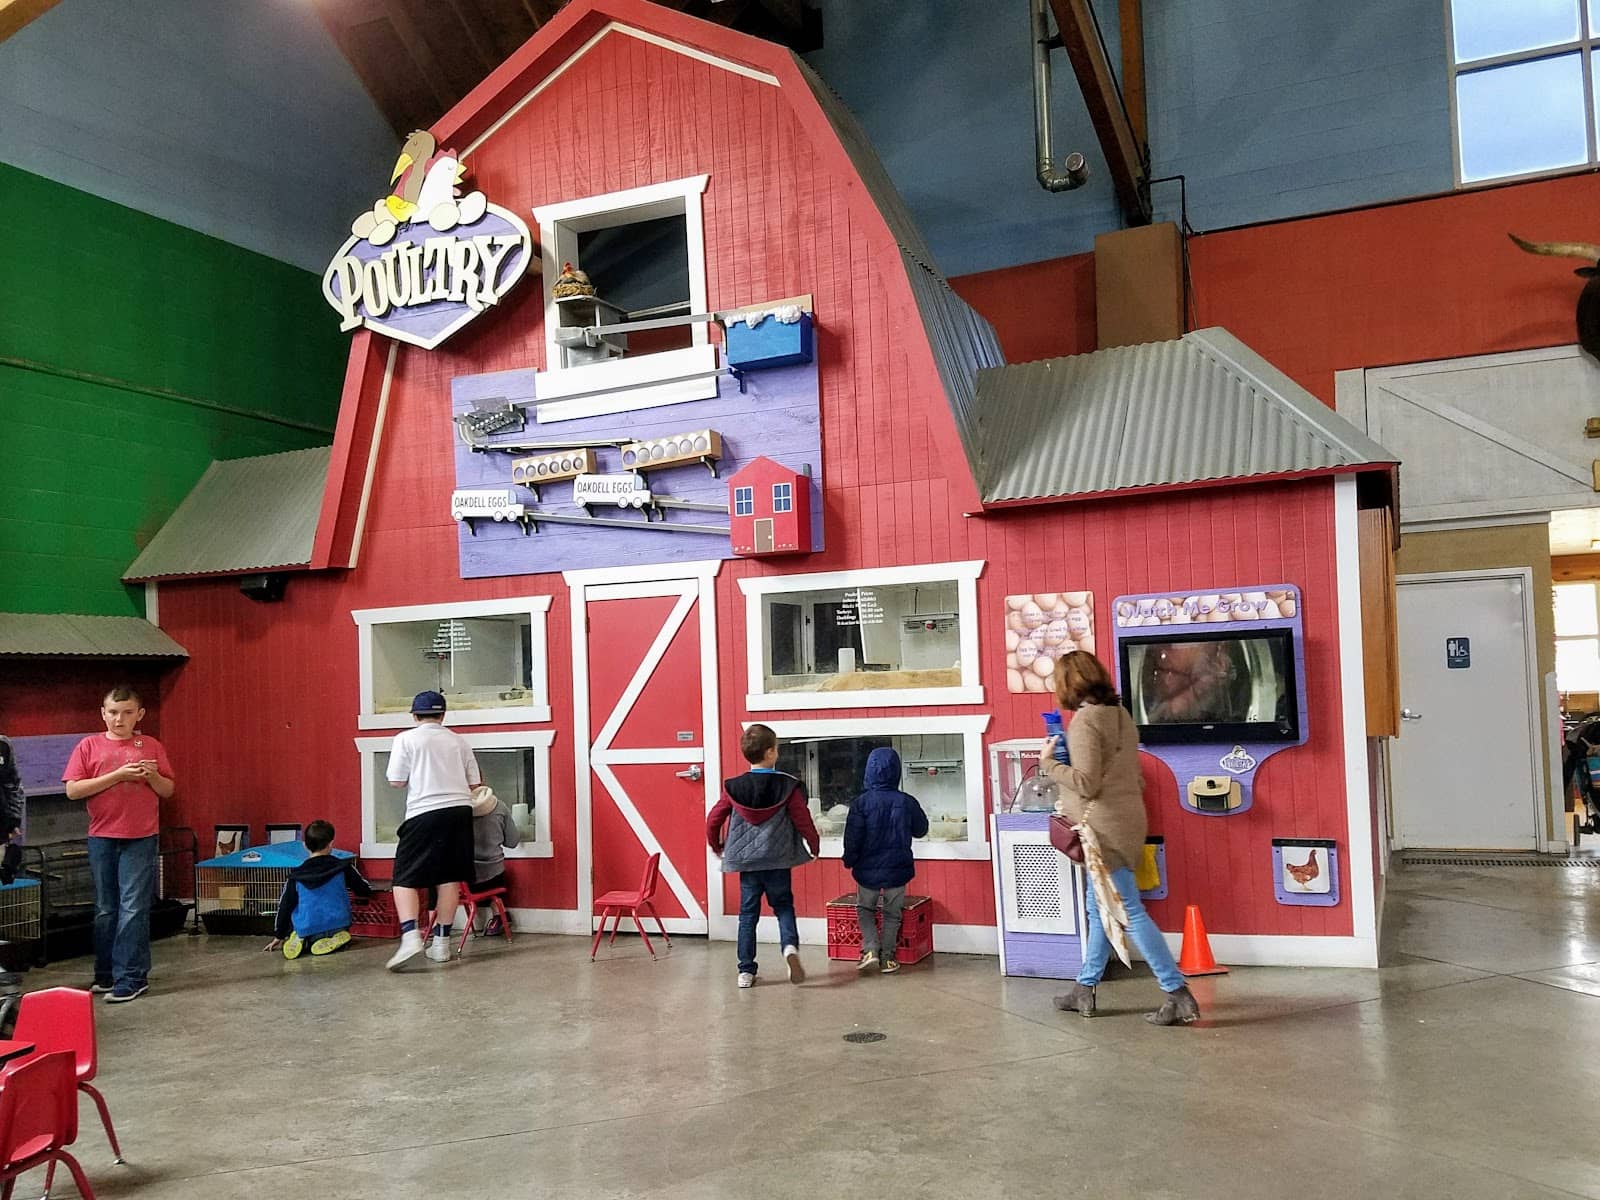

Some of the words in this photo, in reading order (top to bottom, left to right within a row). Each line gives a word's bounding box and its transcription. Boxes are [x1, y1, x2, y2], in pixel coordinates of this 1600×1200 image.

[339, 234, 522, 332] POULTRY
[577, 481, 610, 494] OAKDELL
[612, 481, 633, 494] EGGS
[454, 496, 486, 509] OAKDELL
[487, 495, 507, 508] EGGS
[1123, 602, 1178, 619] Watch
[1183, 601, 1211, 616] Me
[1216, 598, 1270, 614] Grow
